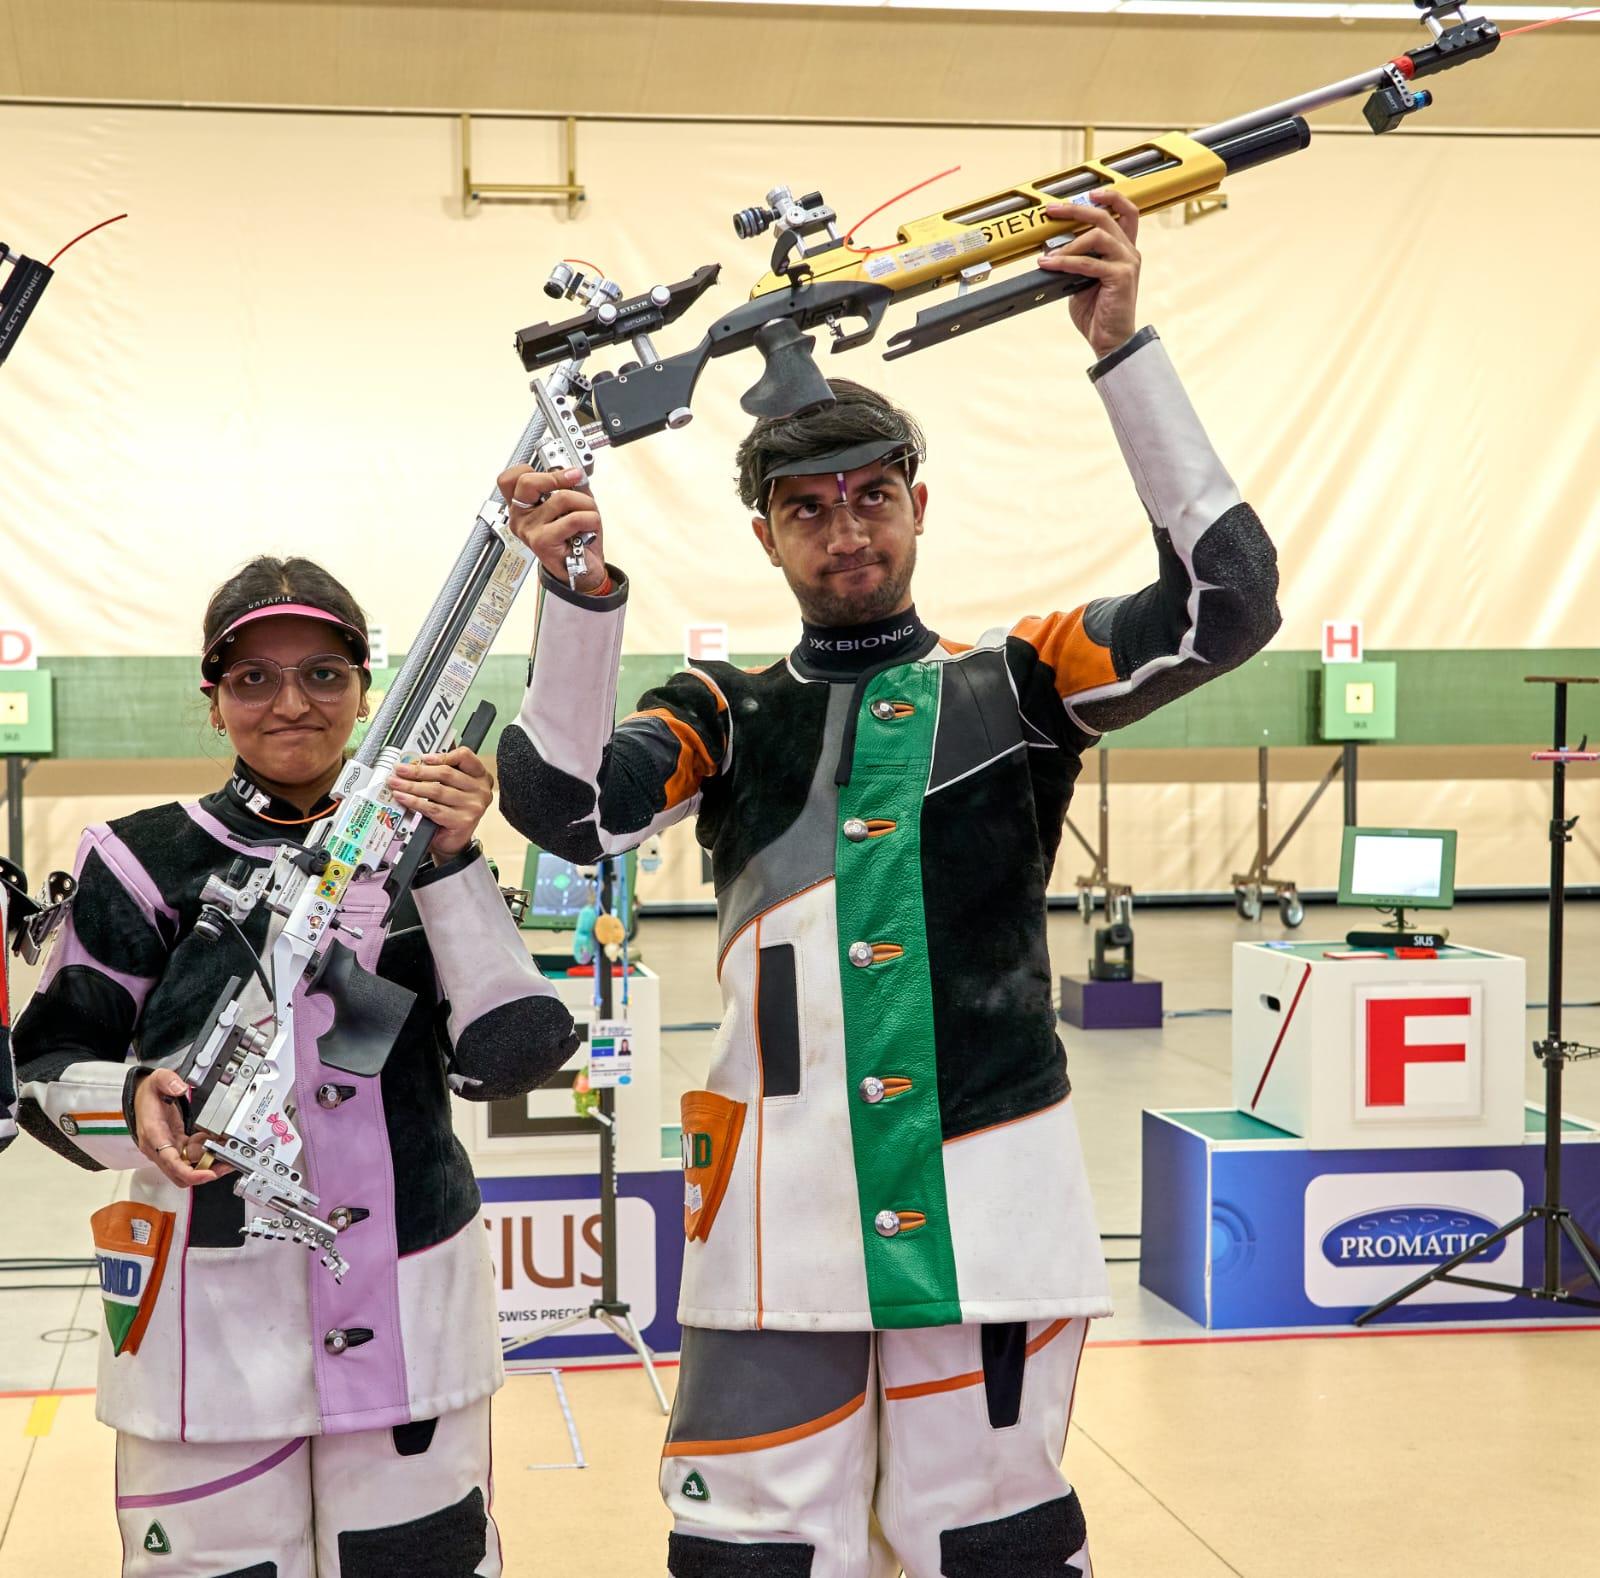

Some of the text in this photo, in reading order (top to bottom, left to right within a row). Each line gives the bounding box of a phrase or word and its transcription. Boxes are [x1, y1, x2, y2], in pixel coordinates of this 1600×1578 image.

[980, 206, 1051, 242] STEYR
[0, 629, 32, 665] D
[689, 628, 722, 660] F
[836, 625, 914, 651] BIONIC
[1326, 625, 1359, 658] H
[1365, 997, 1472, 1107] F
[484, 1214, 604, 1290] IUS
[1340, 1233, 1488, 1259] PROMATIC
[498, 1310, 537, 1322] SWISS
